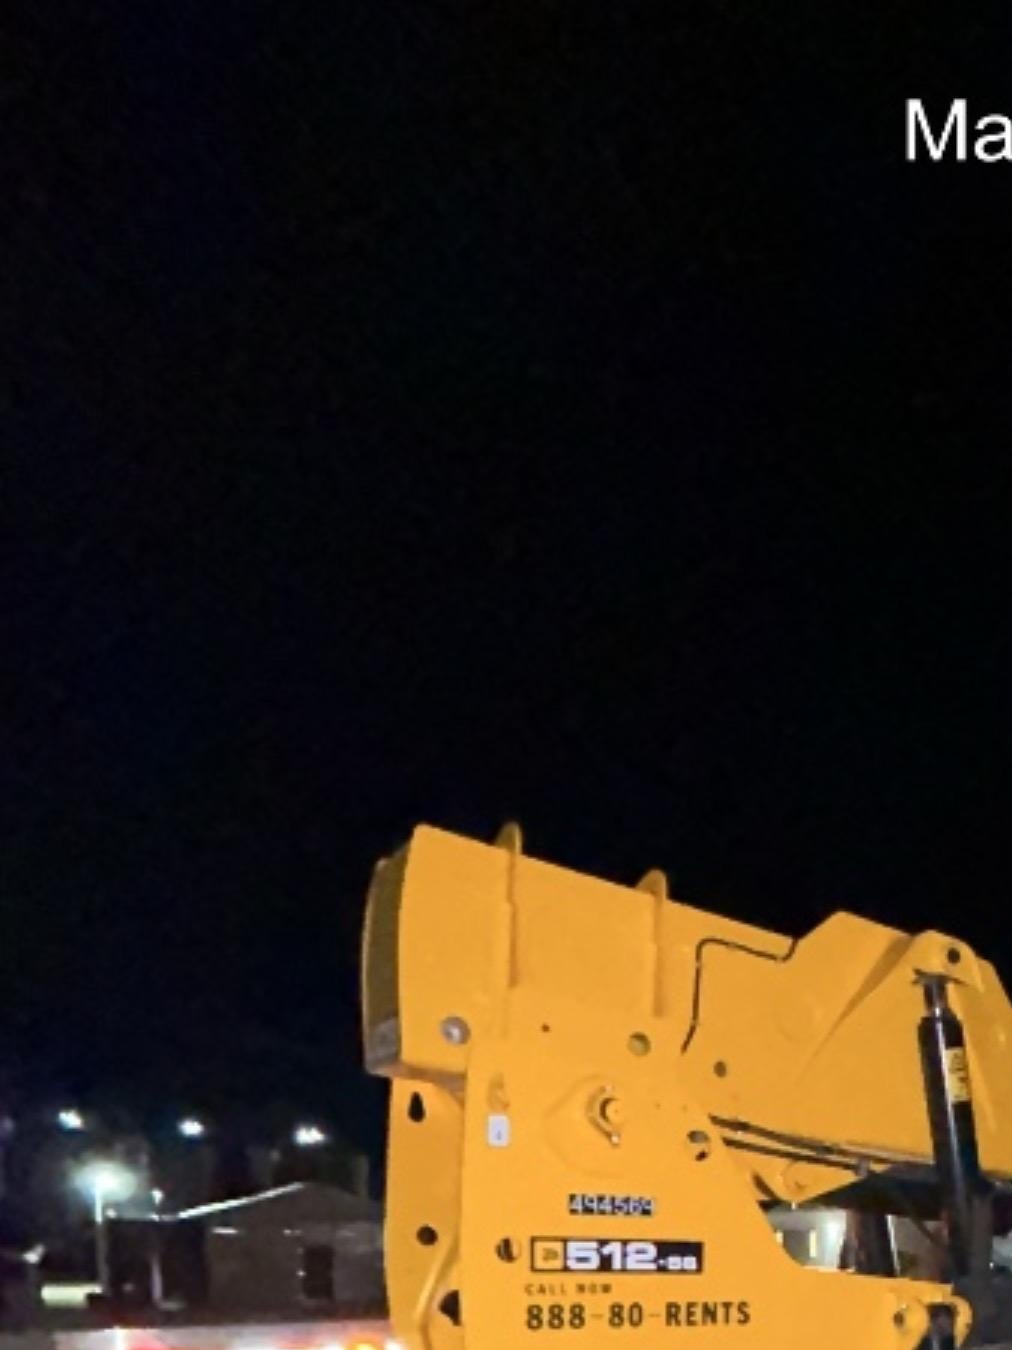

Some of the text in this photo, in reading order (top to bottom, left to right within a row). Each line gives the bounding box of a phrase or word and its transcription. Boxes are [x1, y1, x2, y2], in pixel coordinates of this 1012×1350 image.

[524, 1282, 613, 1296] CALL NOW
[526, 1300, 752, 1331] 888-80-RENTS
